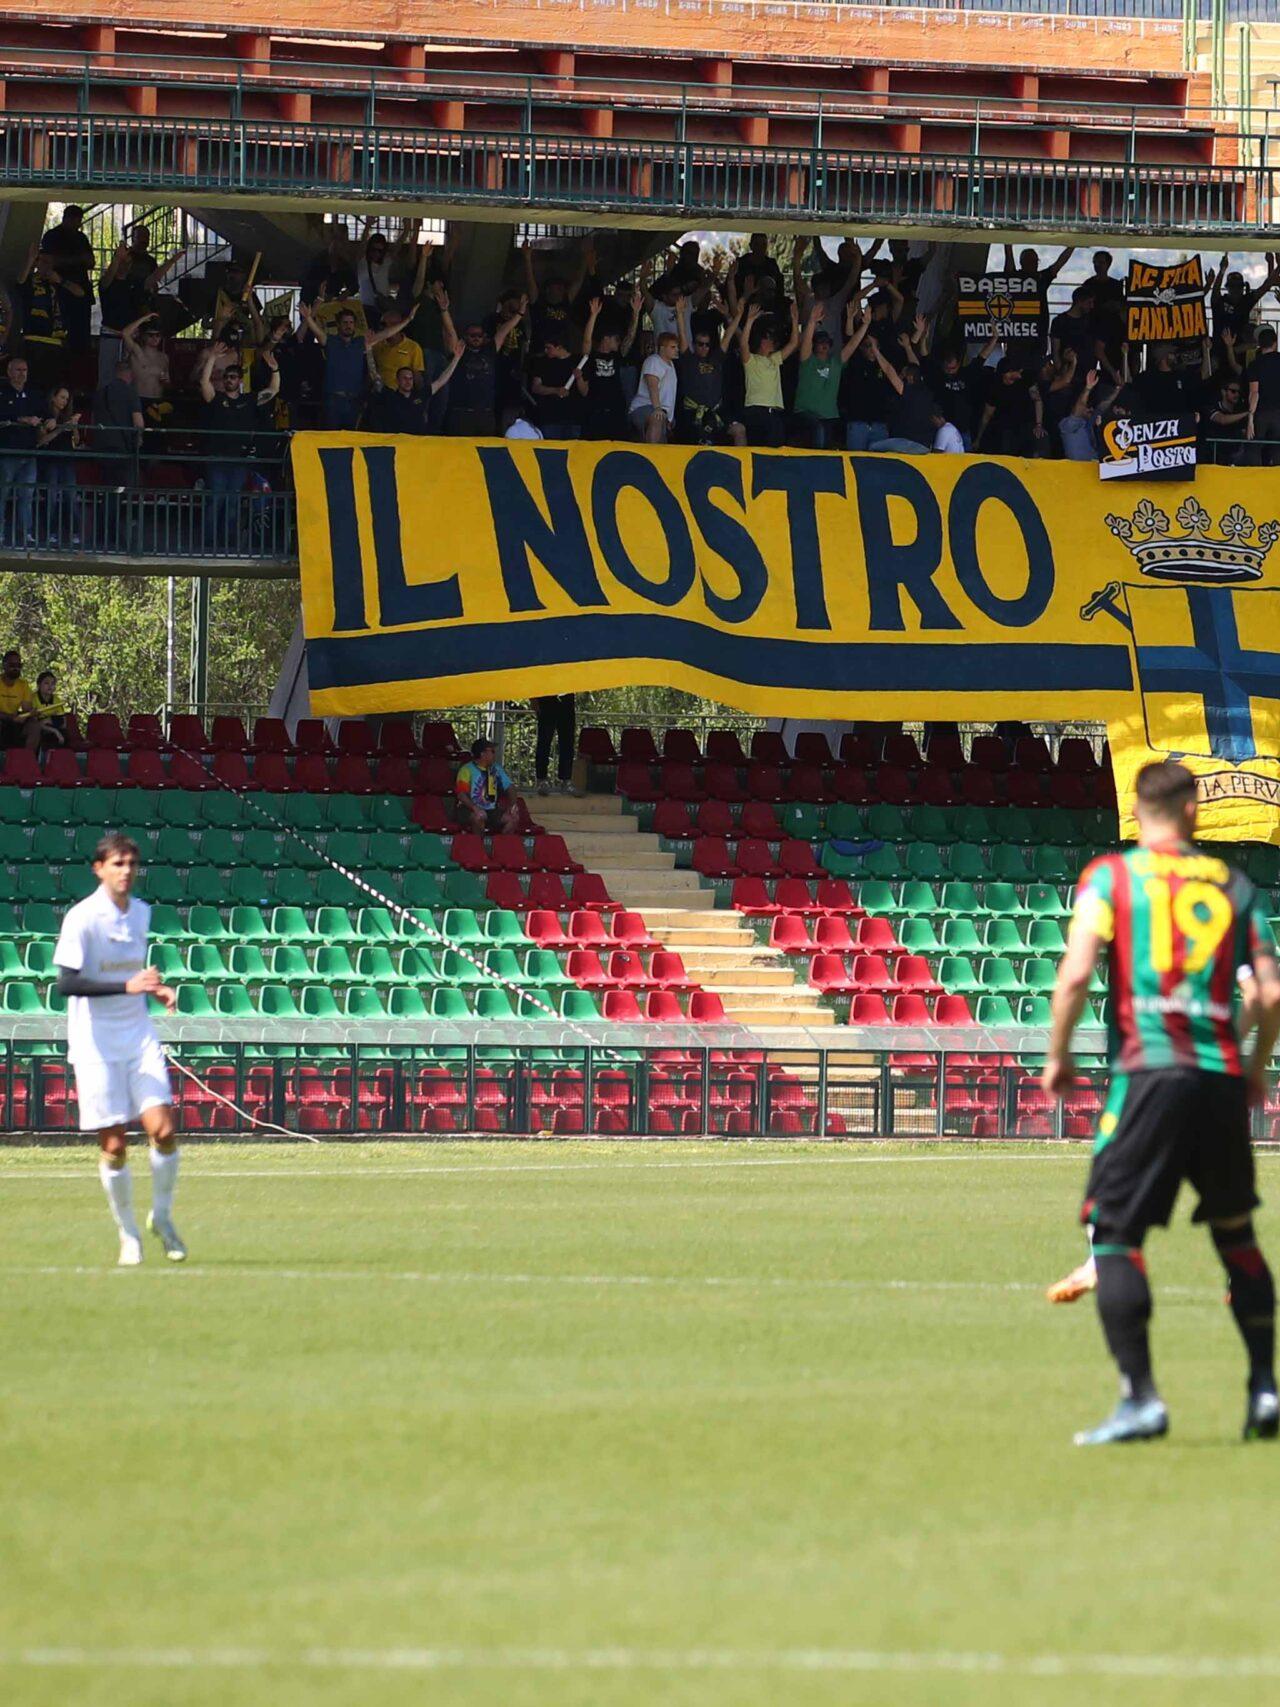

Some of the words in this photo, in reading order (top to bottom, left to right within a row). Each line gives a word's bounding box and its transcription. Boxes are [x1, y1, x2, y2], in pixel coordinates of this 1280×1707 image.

[959, 277, 1038, 293] BASSA
[1131, 263, 1158, 292] AC
[964, 322, 1039, 337] MODENESE
[1128, 302, 1206, 340] CANLADA
[319, 446, 463, 631] IL
[476, 447, 1056, 632] NOSTRO
[1144, 877, 1233, 973] 19
